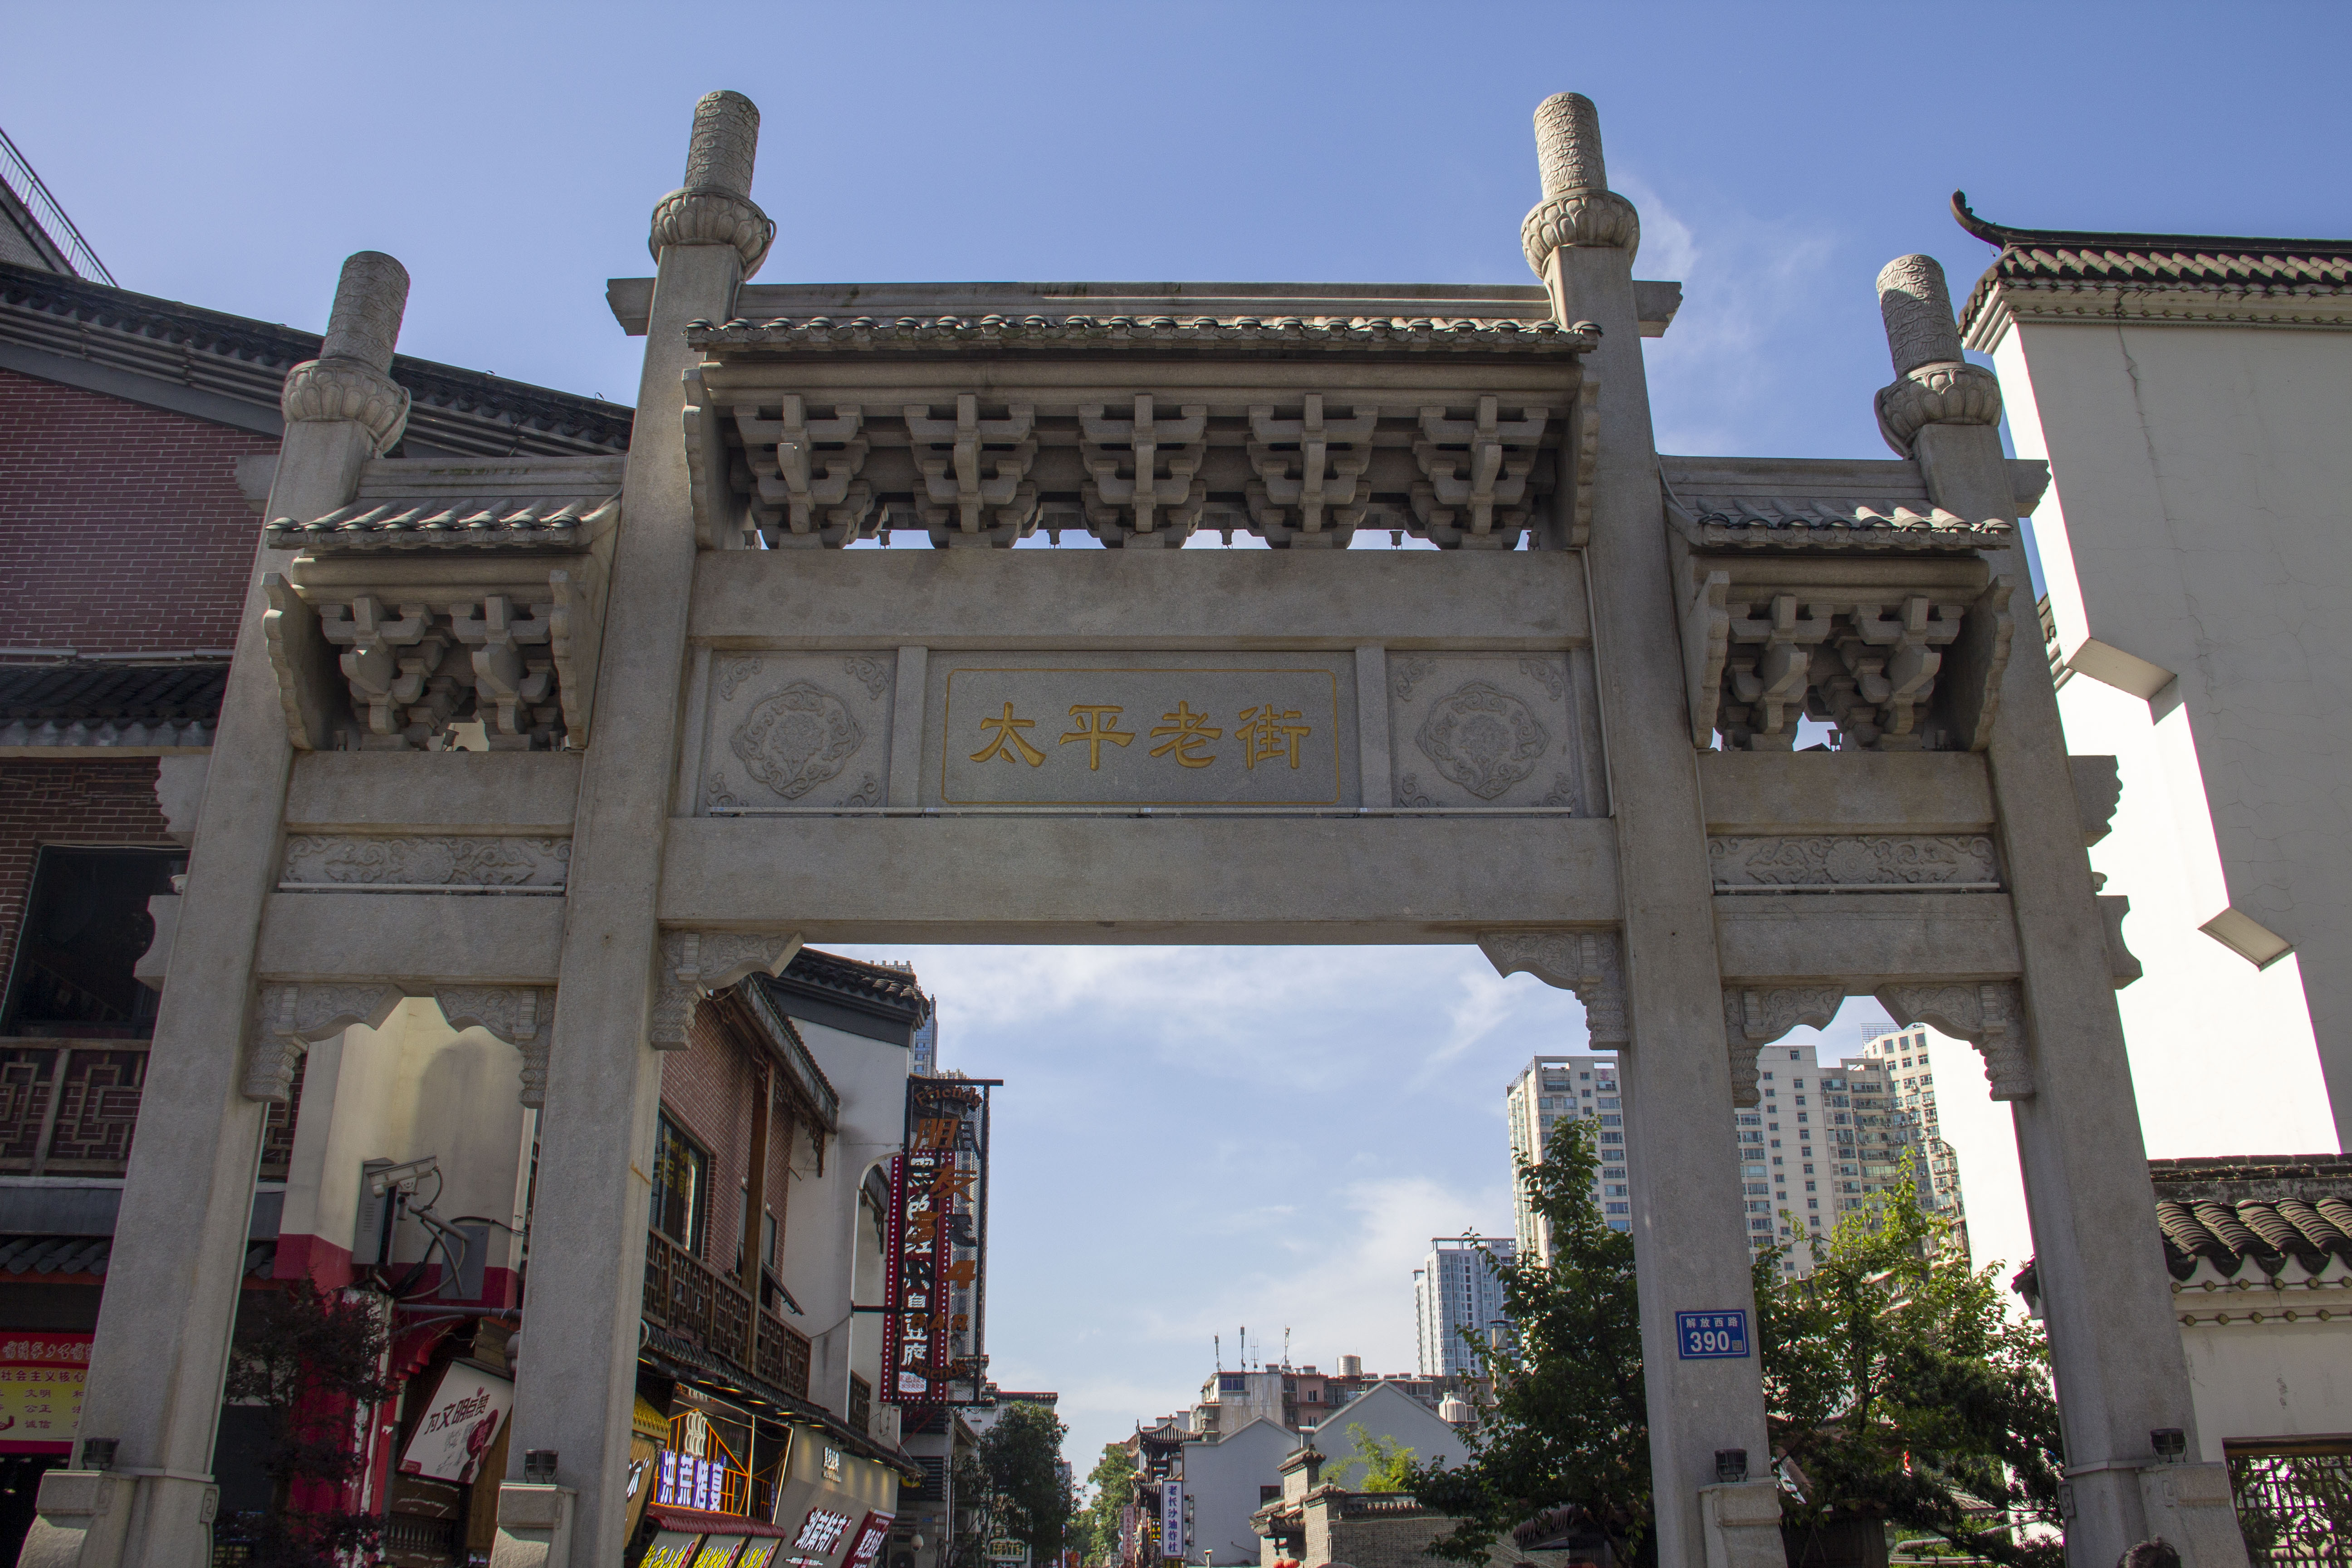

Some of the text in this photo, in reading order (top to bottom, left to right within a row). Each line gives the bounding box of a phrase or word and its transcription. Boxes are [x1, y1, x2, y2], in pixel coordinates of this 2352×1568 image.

[969, 701, 1312, 771] 太平老街
[913, 1086, 983, 1107] Friends
[910, 1313, 968, 1331] BAR
[1686, 1317, 1738, 1328] 解放西路
[1690, 1331, 1730, 1352] 390
[1, 1370, 85, 1382] 社会主义核心
[907, 1360, 967, 1380] Friends
[24, 1389, 51, 1397] 文明
[24, 1405, 51, 1413] 公正
[424, 1394, 490, 1435] 为文明点赞
[1168, 1485, 1178, 1552] 老长沙油炸社
[794, 1508, 847, 1553] 湖南特产
